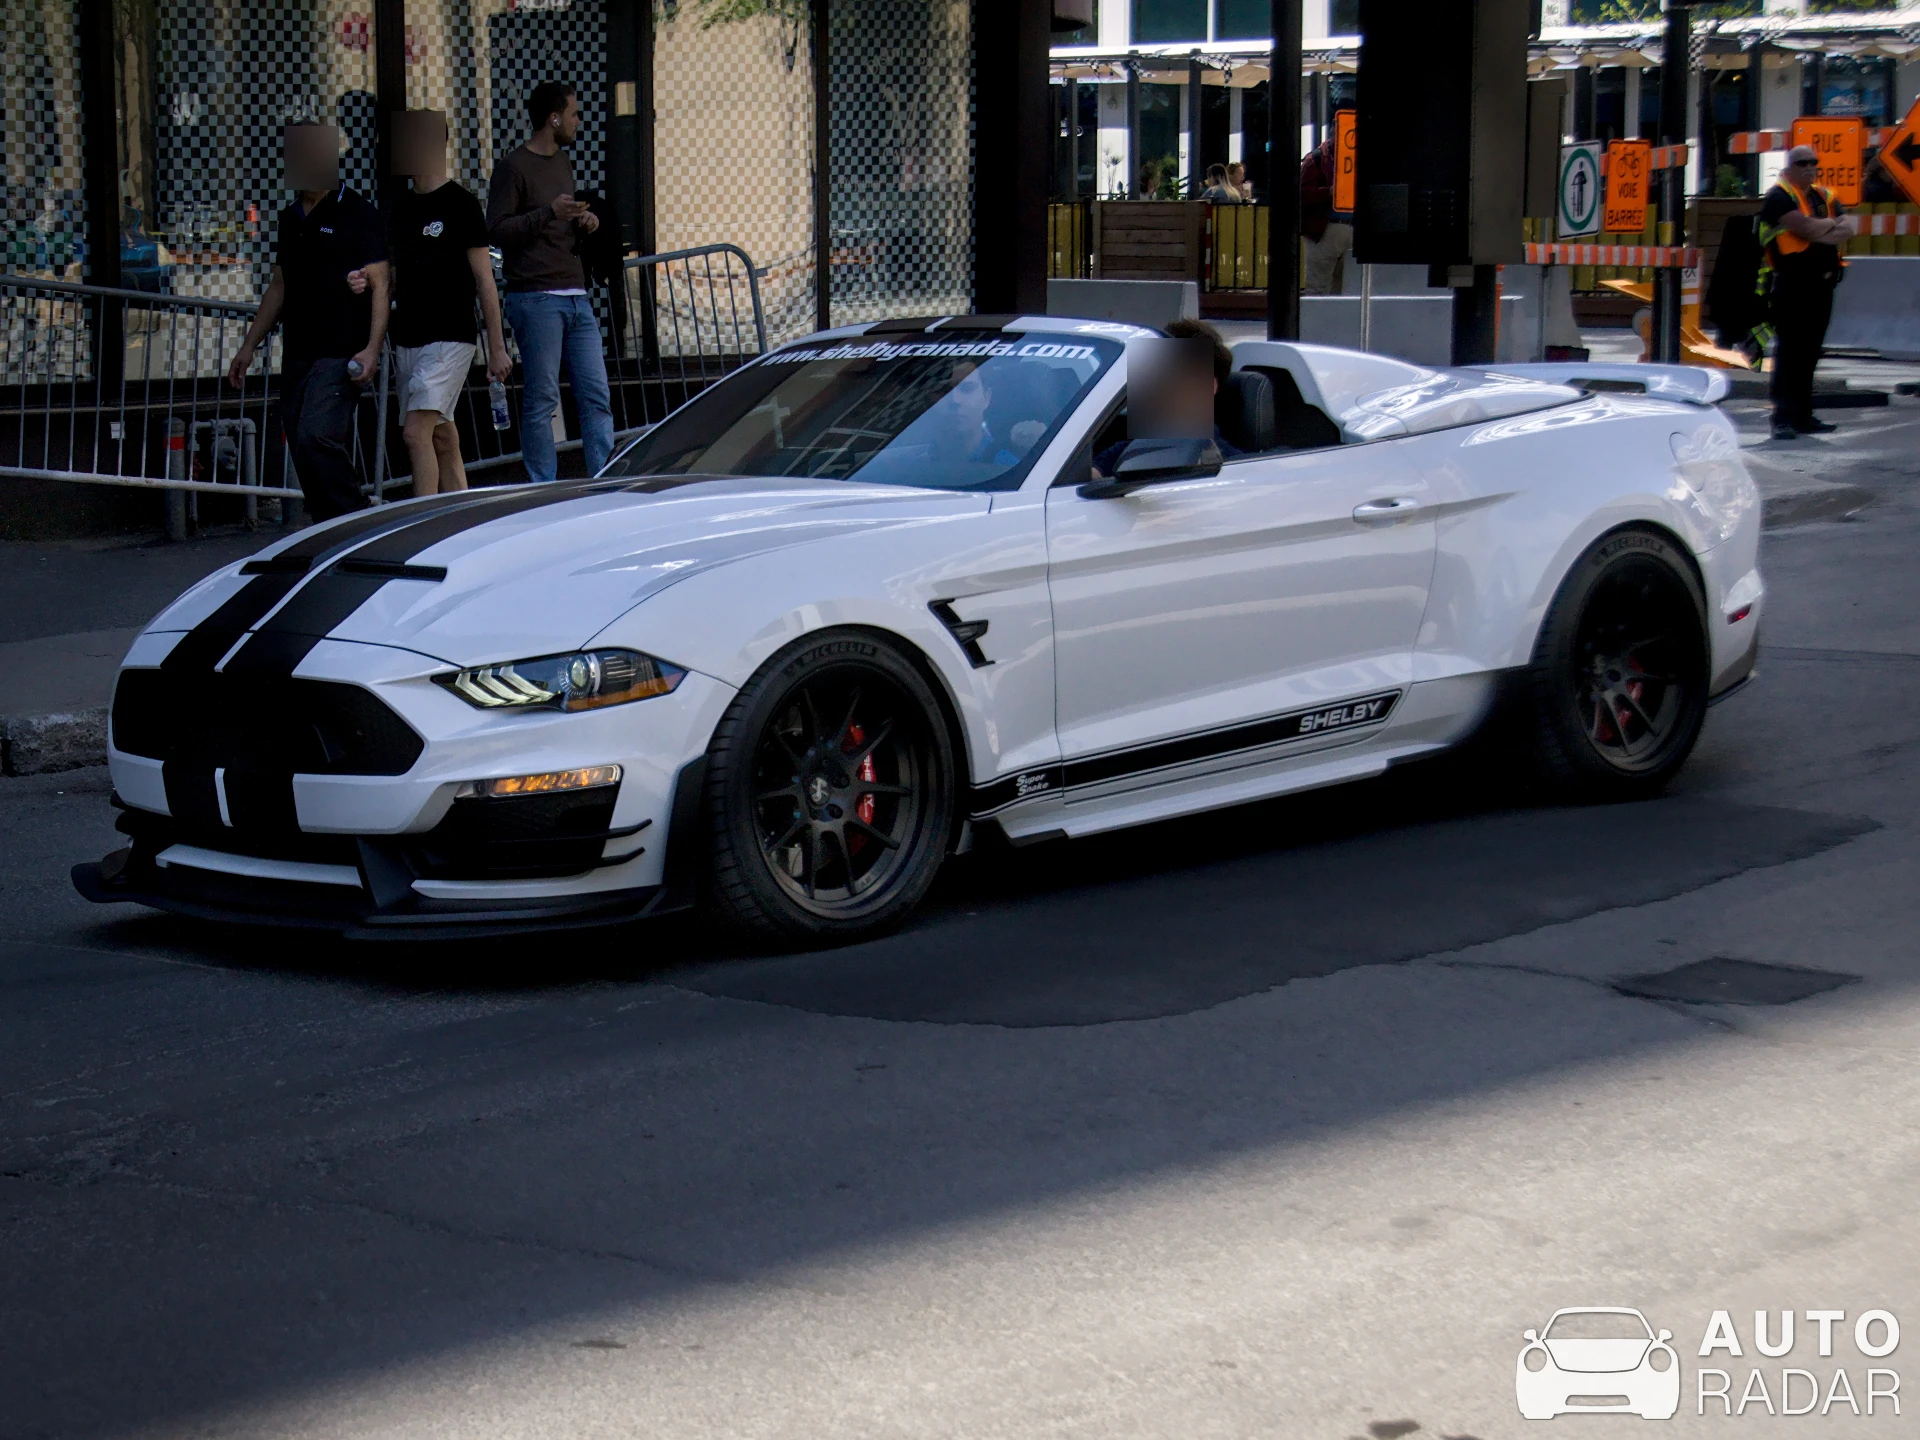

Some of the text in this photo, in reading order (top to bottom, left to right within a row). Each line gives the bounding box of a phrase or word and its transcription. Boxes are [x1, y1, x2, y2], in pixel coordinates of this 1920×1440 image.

[1812, 133, 1843, 154] RUE
[1815, 163, 1857, 187] RRÉE
[1617, 182, 1639, 199] VOIE
[760, 339, 1097, 367] www.shelbycanada.com
[1299, 700, 1385, 733] SHELBY
[1015, 773, 1047, 787] Super
[1017, 782, 1050, 797] Snake
